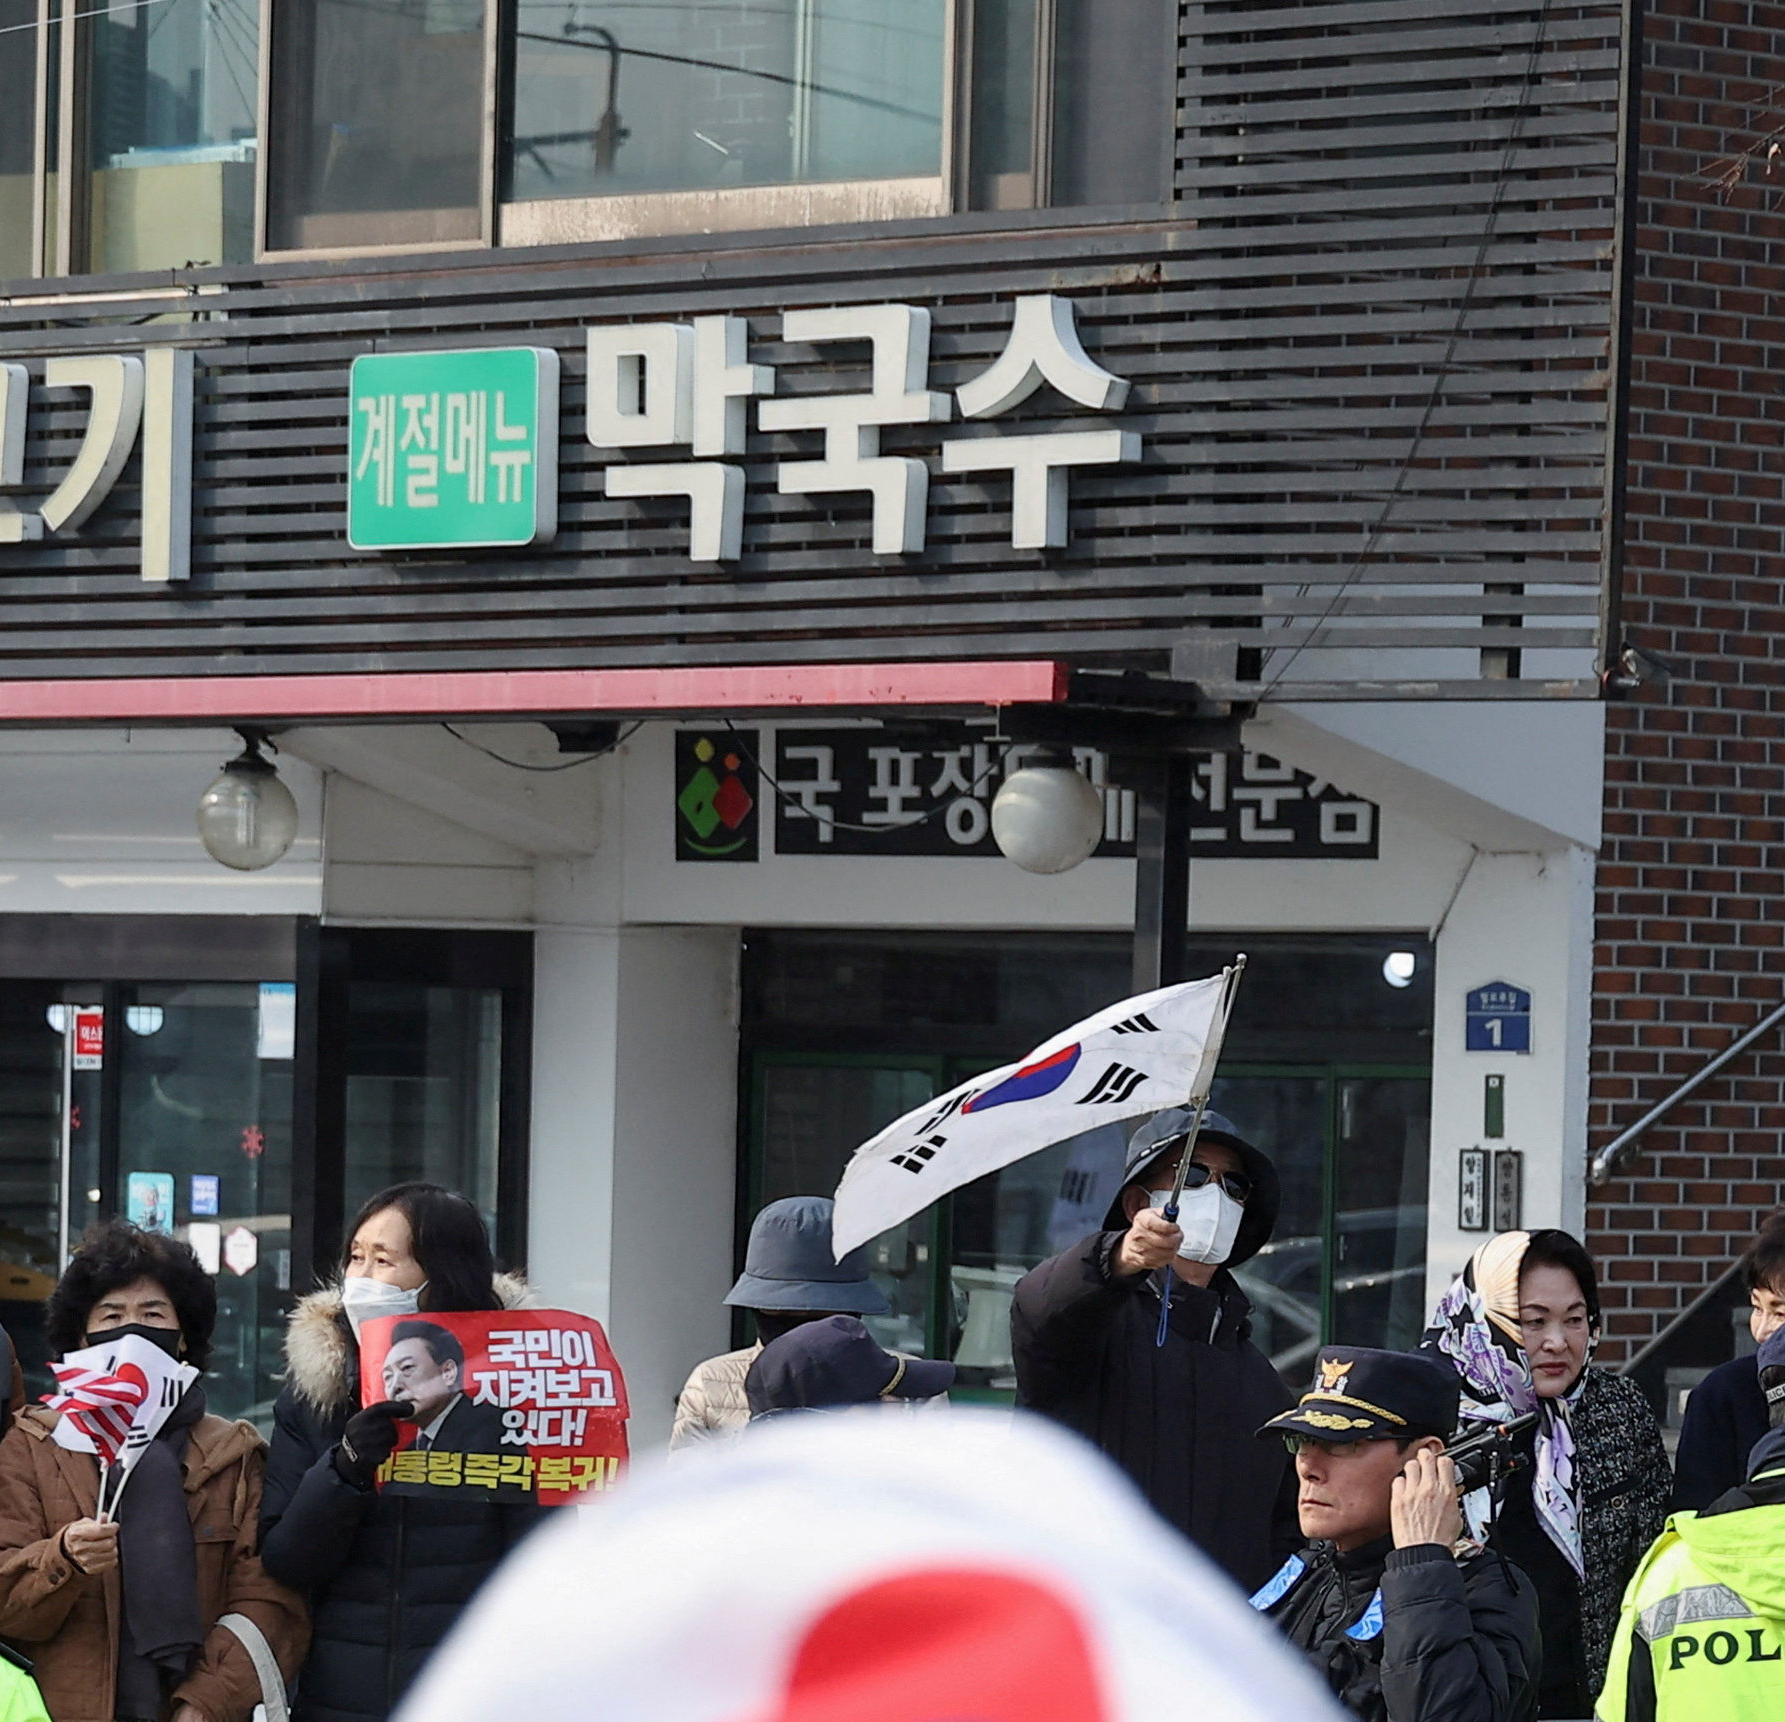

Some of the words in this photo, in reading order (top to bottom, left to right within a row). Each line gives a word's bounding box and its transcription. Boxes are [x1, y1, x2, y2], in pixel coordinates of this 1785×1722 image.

[356, 390, 532, 508] 계절메뉴
[583, 294, 1144, 565] 막국수
[1484, 1018, 1503, 1047] 1
[487, 1329, 597, 1369] 국민이
[472, 1369, 617, 1408] 지켜보고
[500, 1408, 588, 1447] 있다!
[464, 1453, 537, 1491] 즉각
[537, 1456, 619, 1492] 복귀!
